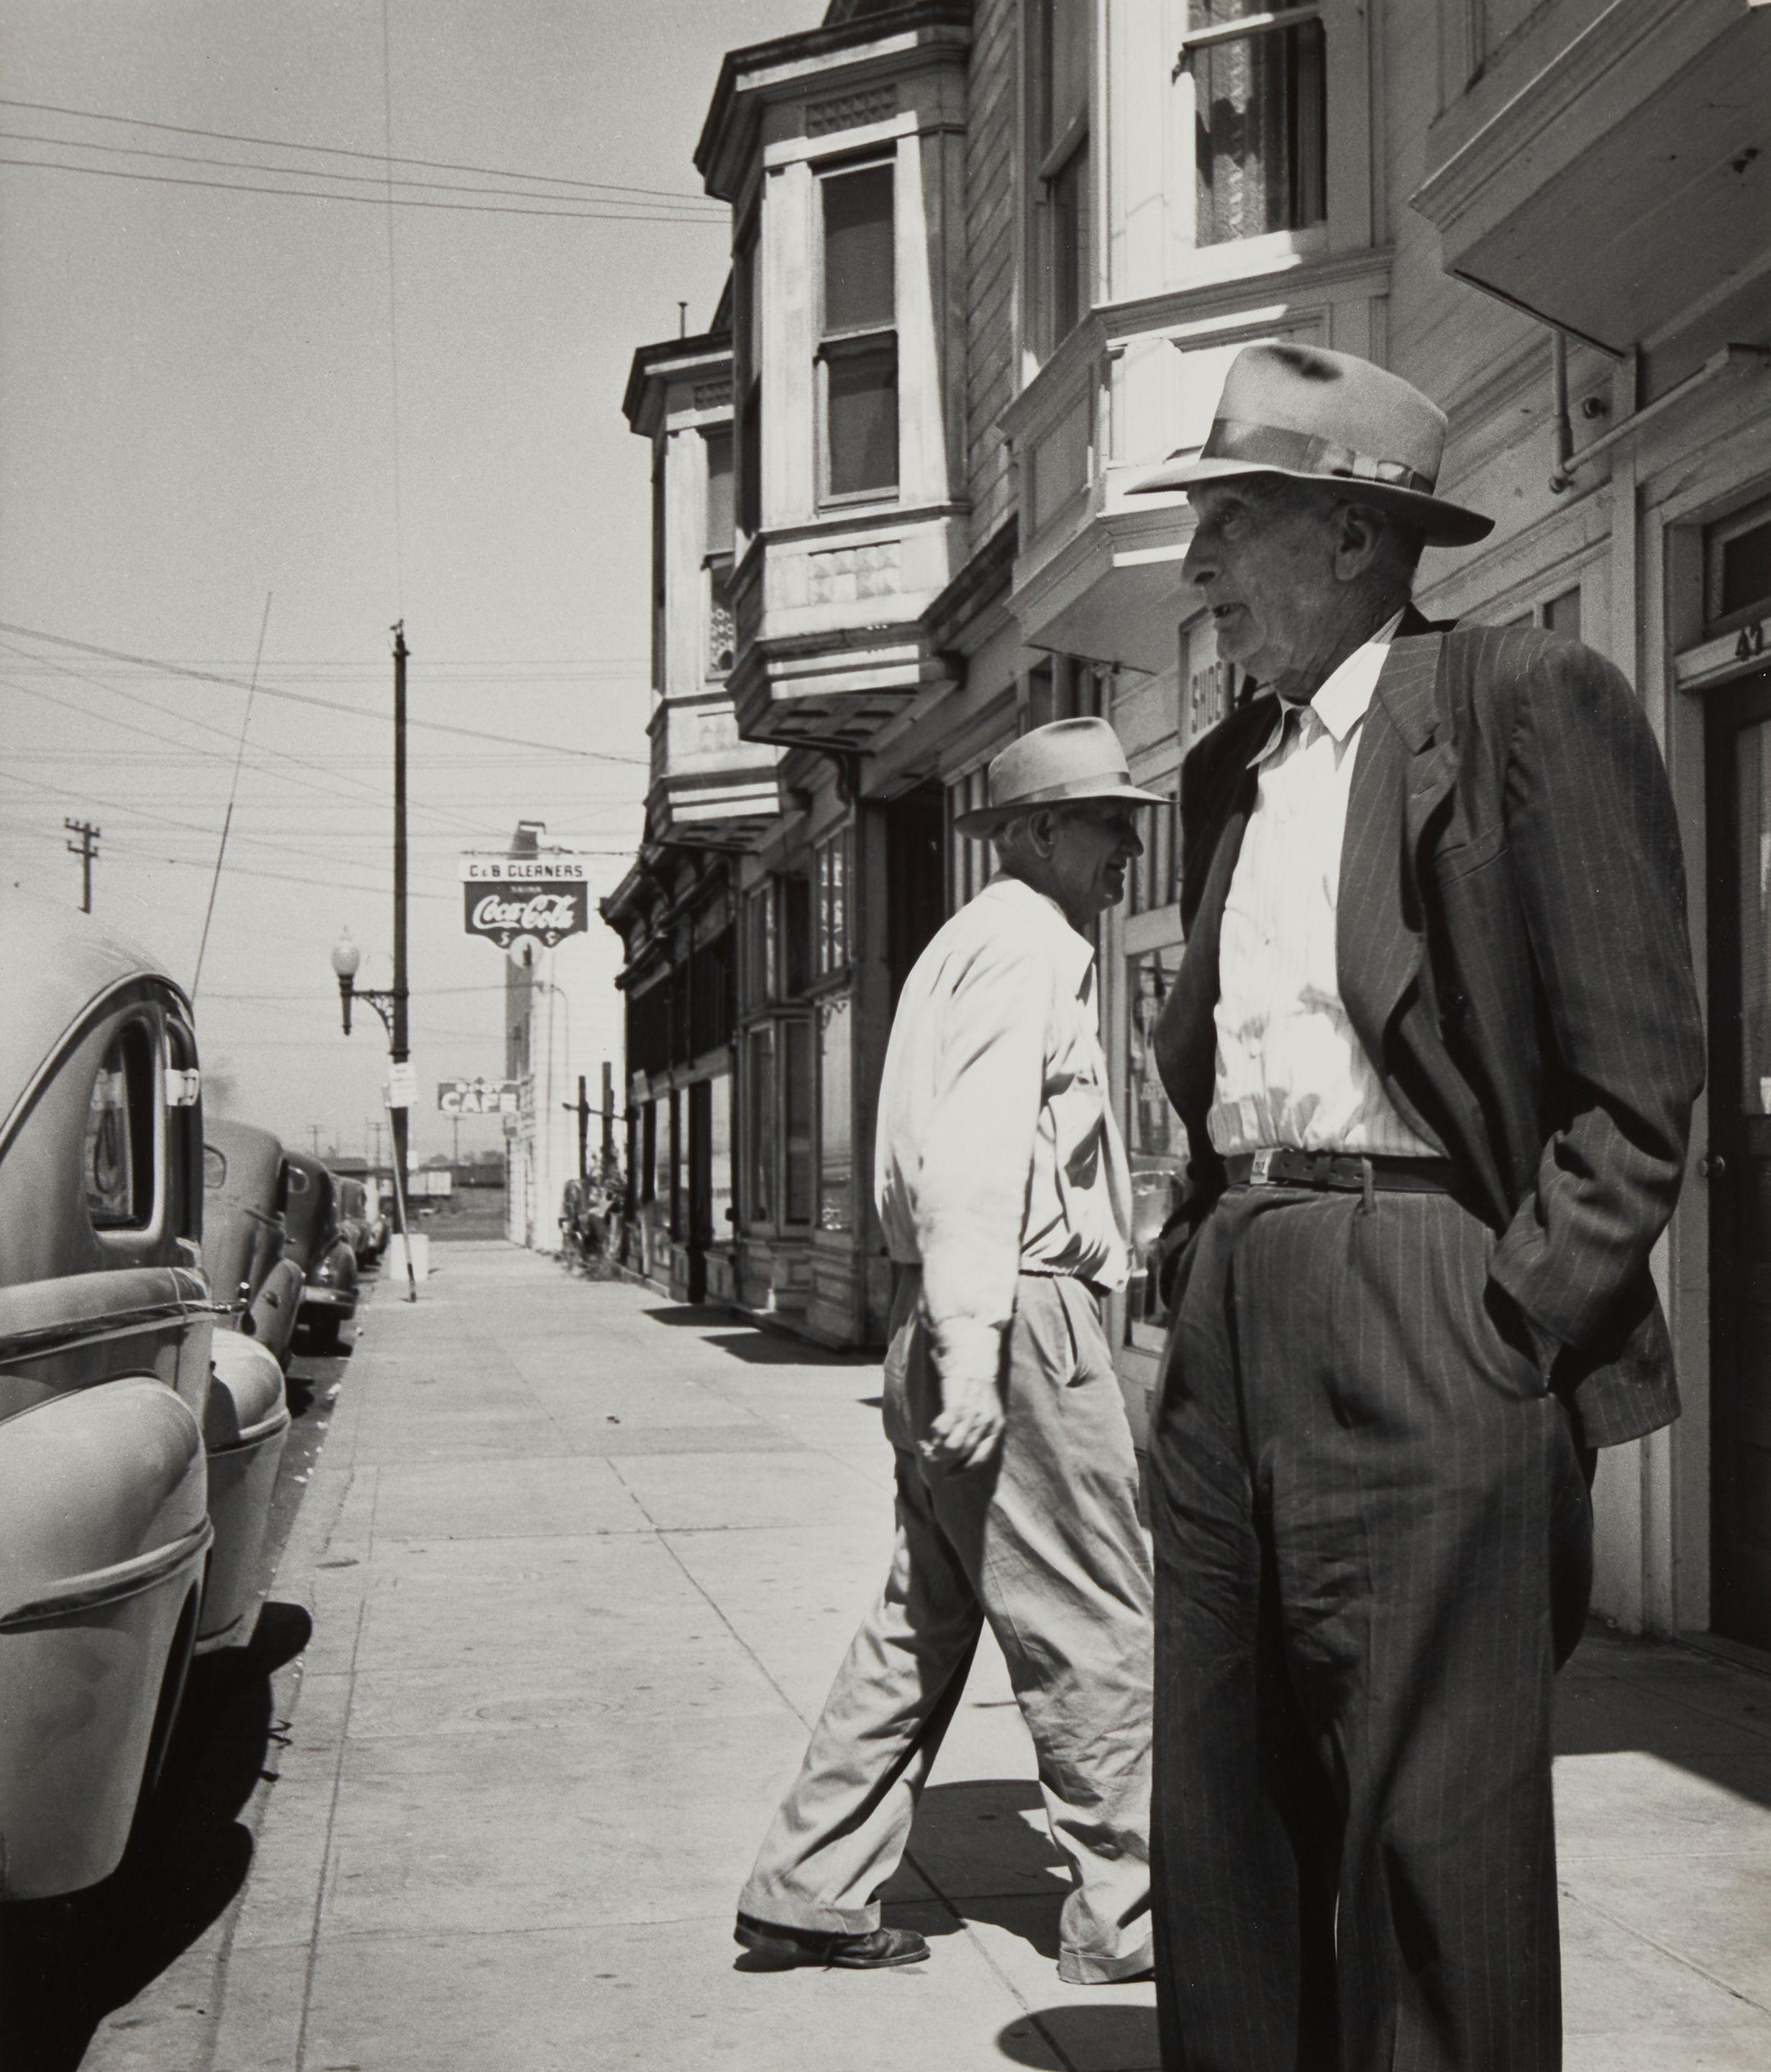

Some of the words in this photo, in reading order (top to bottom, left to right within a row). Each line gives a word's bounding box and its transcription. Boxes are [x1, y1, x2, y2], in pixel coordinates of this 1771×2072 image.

[470, 865, 478, 877] C
[492, 865, 501, 877] B
[508, 865, 583, 877] CLEANERS
[441, 1092, 516, 1112] CAFE
